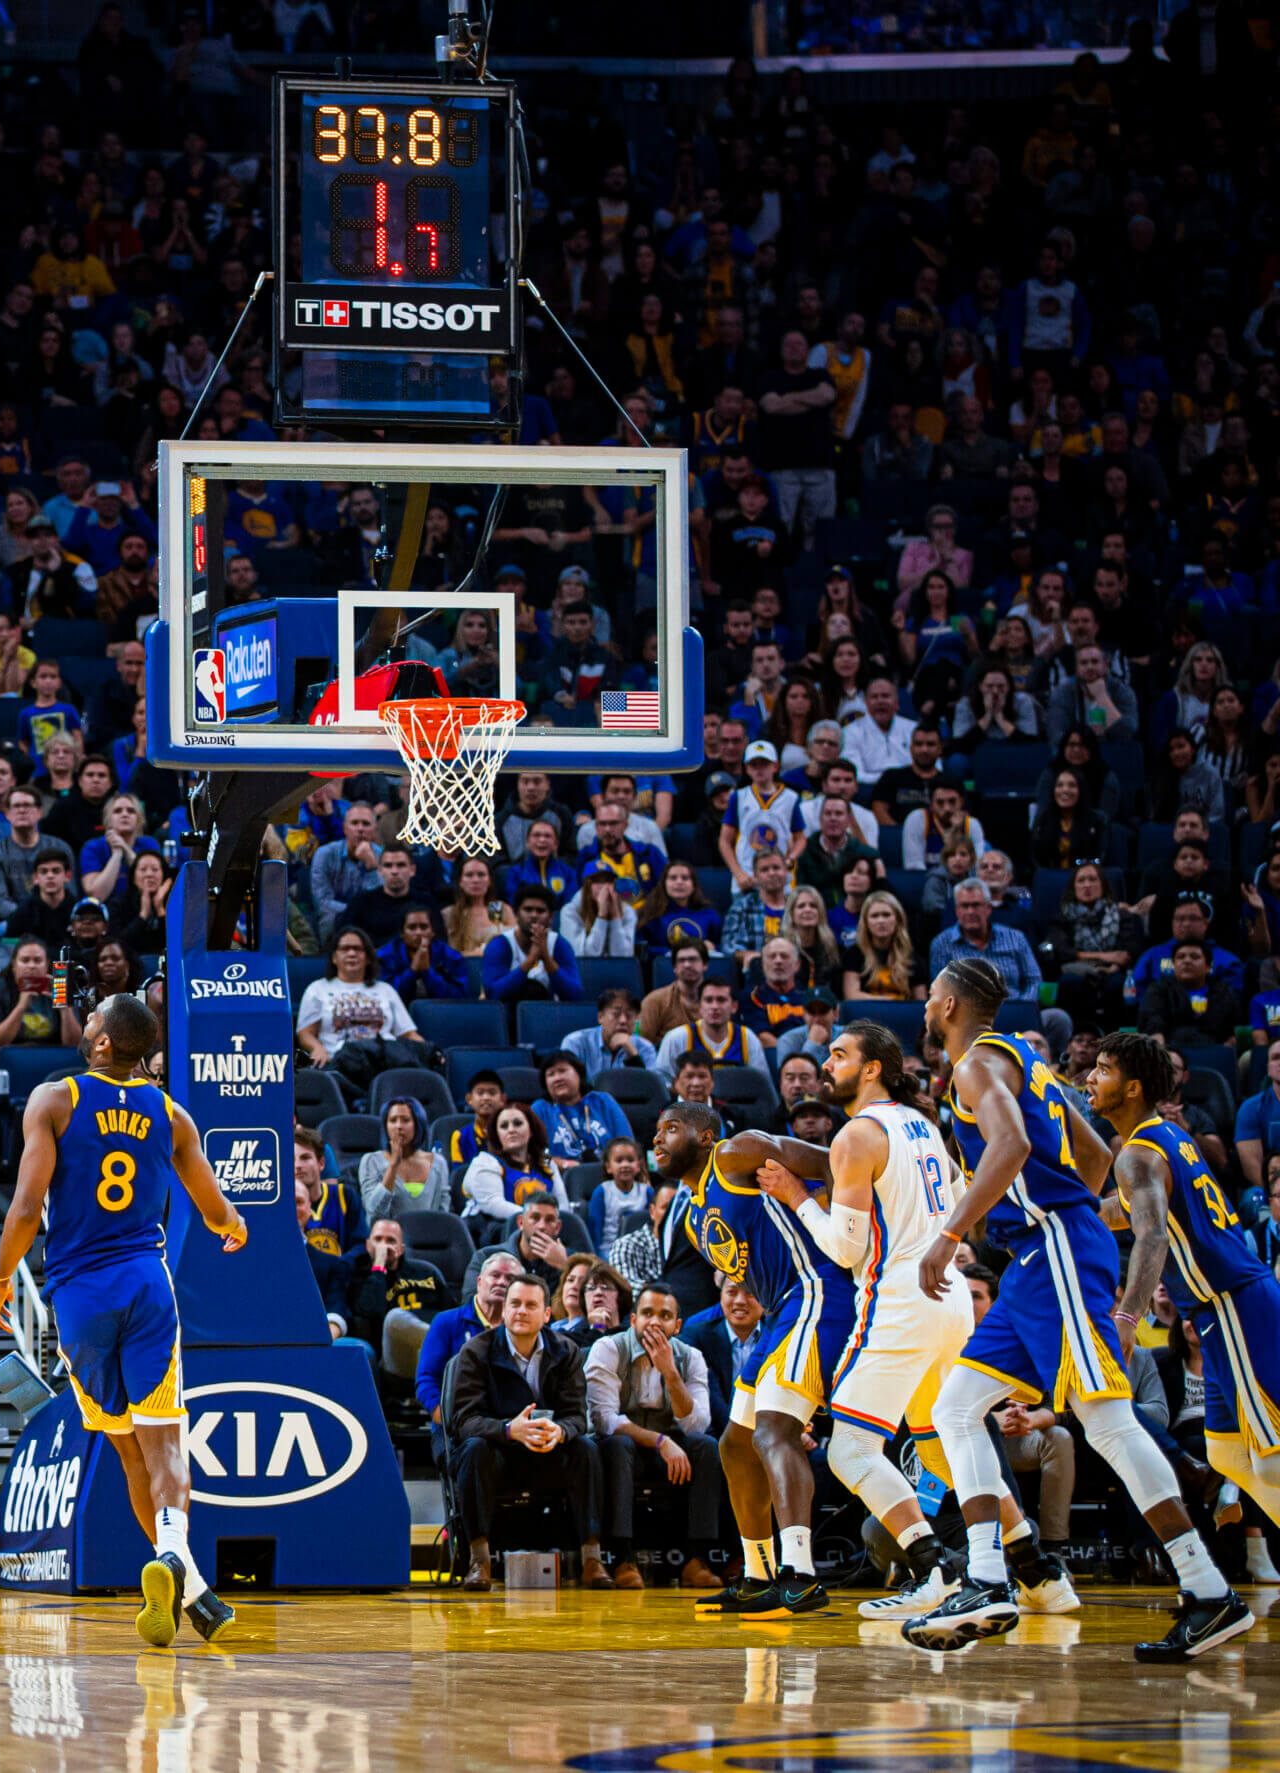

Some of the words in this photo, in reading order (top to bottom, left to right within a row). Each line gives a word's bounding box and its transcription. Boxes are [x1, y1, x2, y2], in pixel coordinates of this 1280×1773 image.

[317, 105, 442, 165] 37.8
[353, 301, 501, 332] TISSOT
[226, 635, 272, 686] Rakuten
[197, 706, 215, 720] NBA
[185, 734, 236, 746] SPALDING
[190, 978, 285, 999] SPALDING
[190, 1053, 289, 1083] TANDUAY
[220, 1084, 262, 1097] RUM
[95, 1108, 152, 1141] BURKS
[230, 1140, 259, 1160] MY
[96, 1150, 137, 1213] 8
[215, 1160, 273, 1179] TEAMS
[230, 1177, 276, 1196] Sports
[915, 1153, 947, 1217] 12
[185, 1411, 328, 1478] KIA
[3, 1438, 82, 1534] thrive
